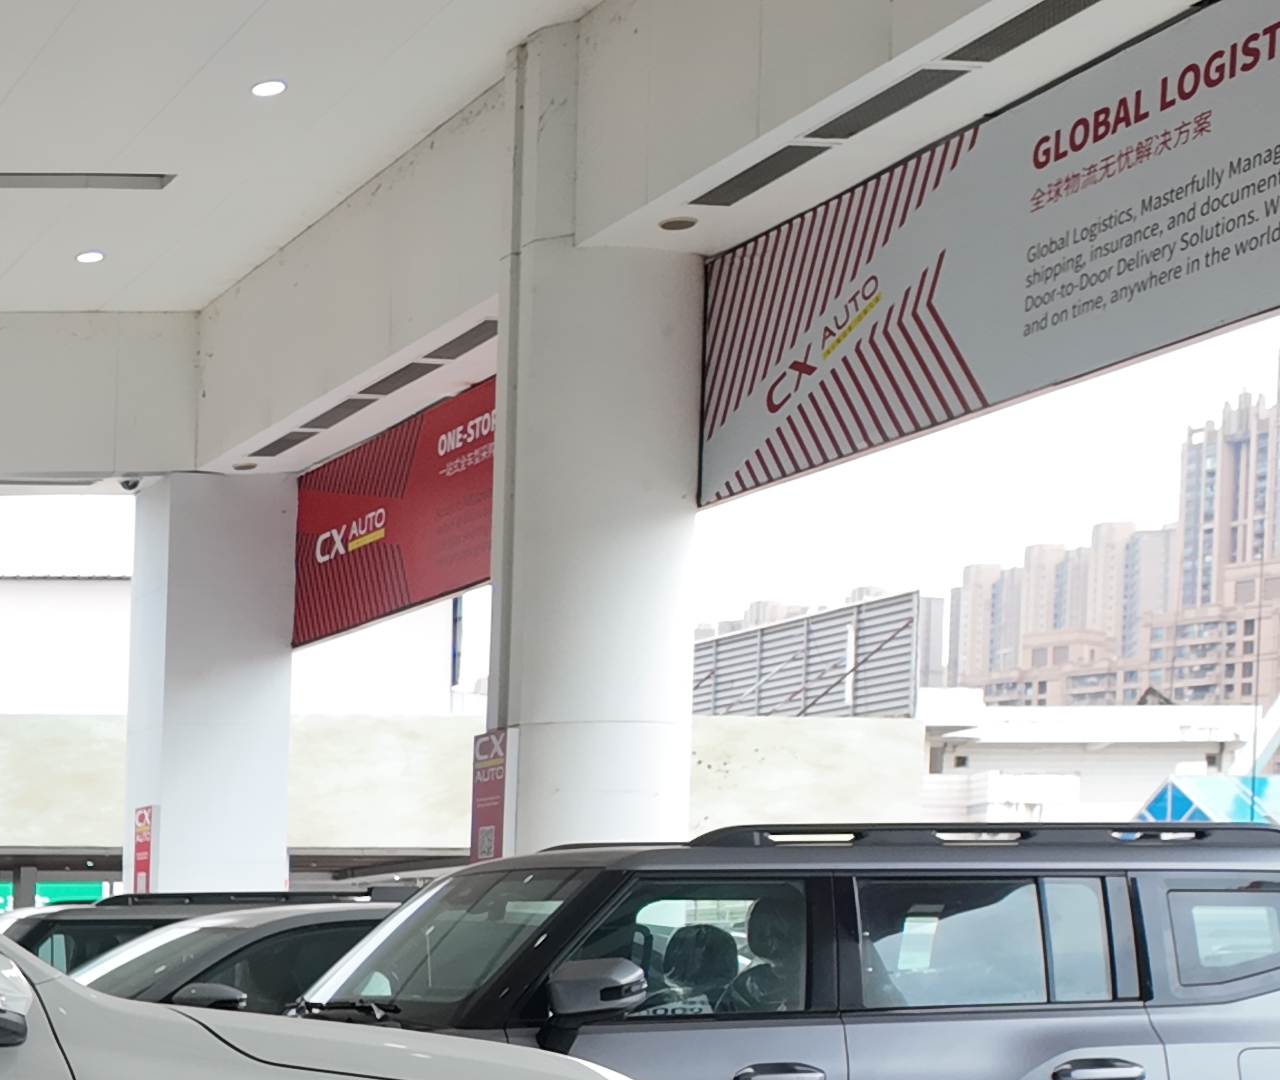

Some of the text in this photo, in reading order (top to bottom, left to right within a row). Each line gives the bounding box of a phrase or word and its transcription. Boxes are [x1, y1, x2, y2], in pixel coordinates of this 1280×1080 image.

[1033, 21, 1280, 170] GLOBAL LOGIST
[1030, 110, 1213, 213] 全球物流无忧解决方案
[1024, 265, 1114, 313] Door-to-Door
[1116, 240, 1178, 277] Delivery
[1180, 208, 1260, 251] Solutions.
[1025, 252, 1087, 289] shipping,
[1090, 221, 1164, 262] insurance,
[1166, 202, 1196, 231] and
[1027, 231, 1070, 263] Global
[1073, 207, 1138, 243] Logistics,
[1141, 167, 1225, 216] Masterfully
[1022, 313, 1049, 337] and
[1051, 310, 1069, 326] on
[1071, 294, 1107, 319] time,
[1110, 264, 1182, 304] anywhere
[1186, 256, 1201, 276] in
[1204, 245, 1231, 269] the
[766, 342, 818, 413] CX
[821, 275, 879, 350] AUTO
[315, 523, 347, 564] CX
[348, 508, 386, 541] AUTO
[475, 733, 505, 761] CX
[475, 766, 504, 783] AUTO
[135, 808, 151, 827] CX
